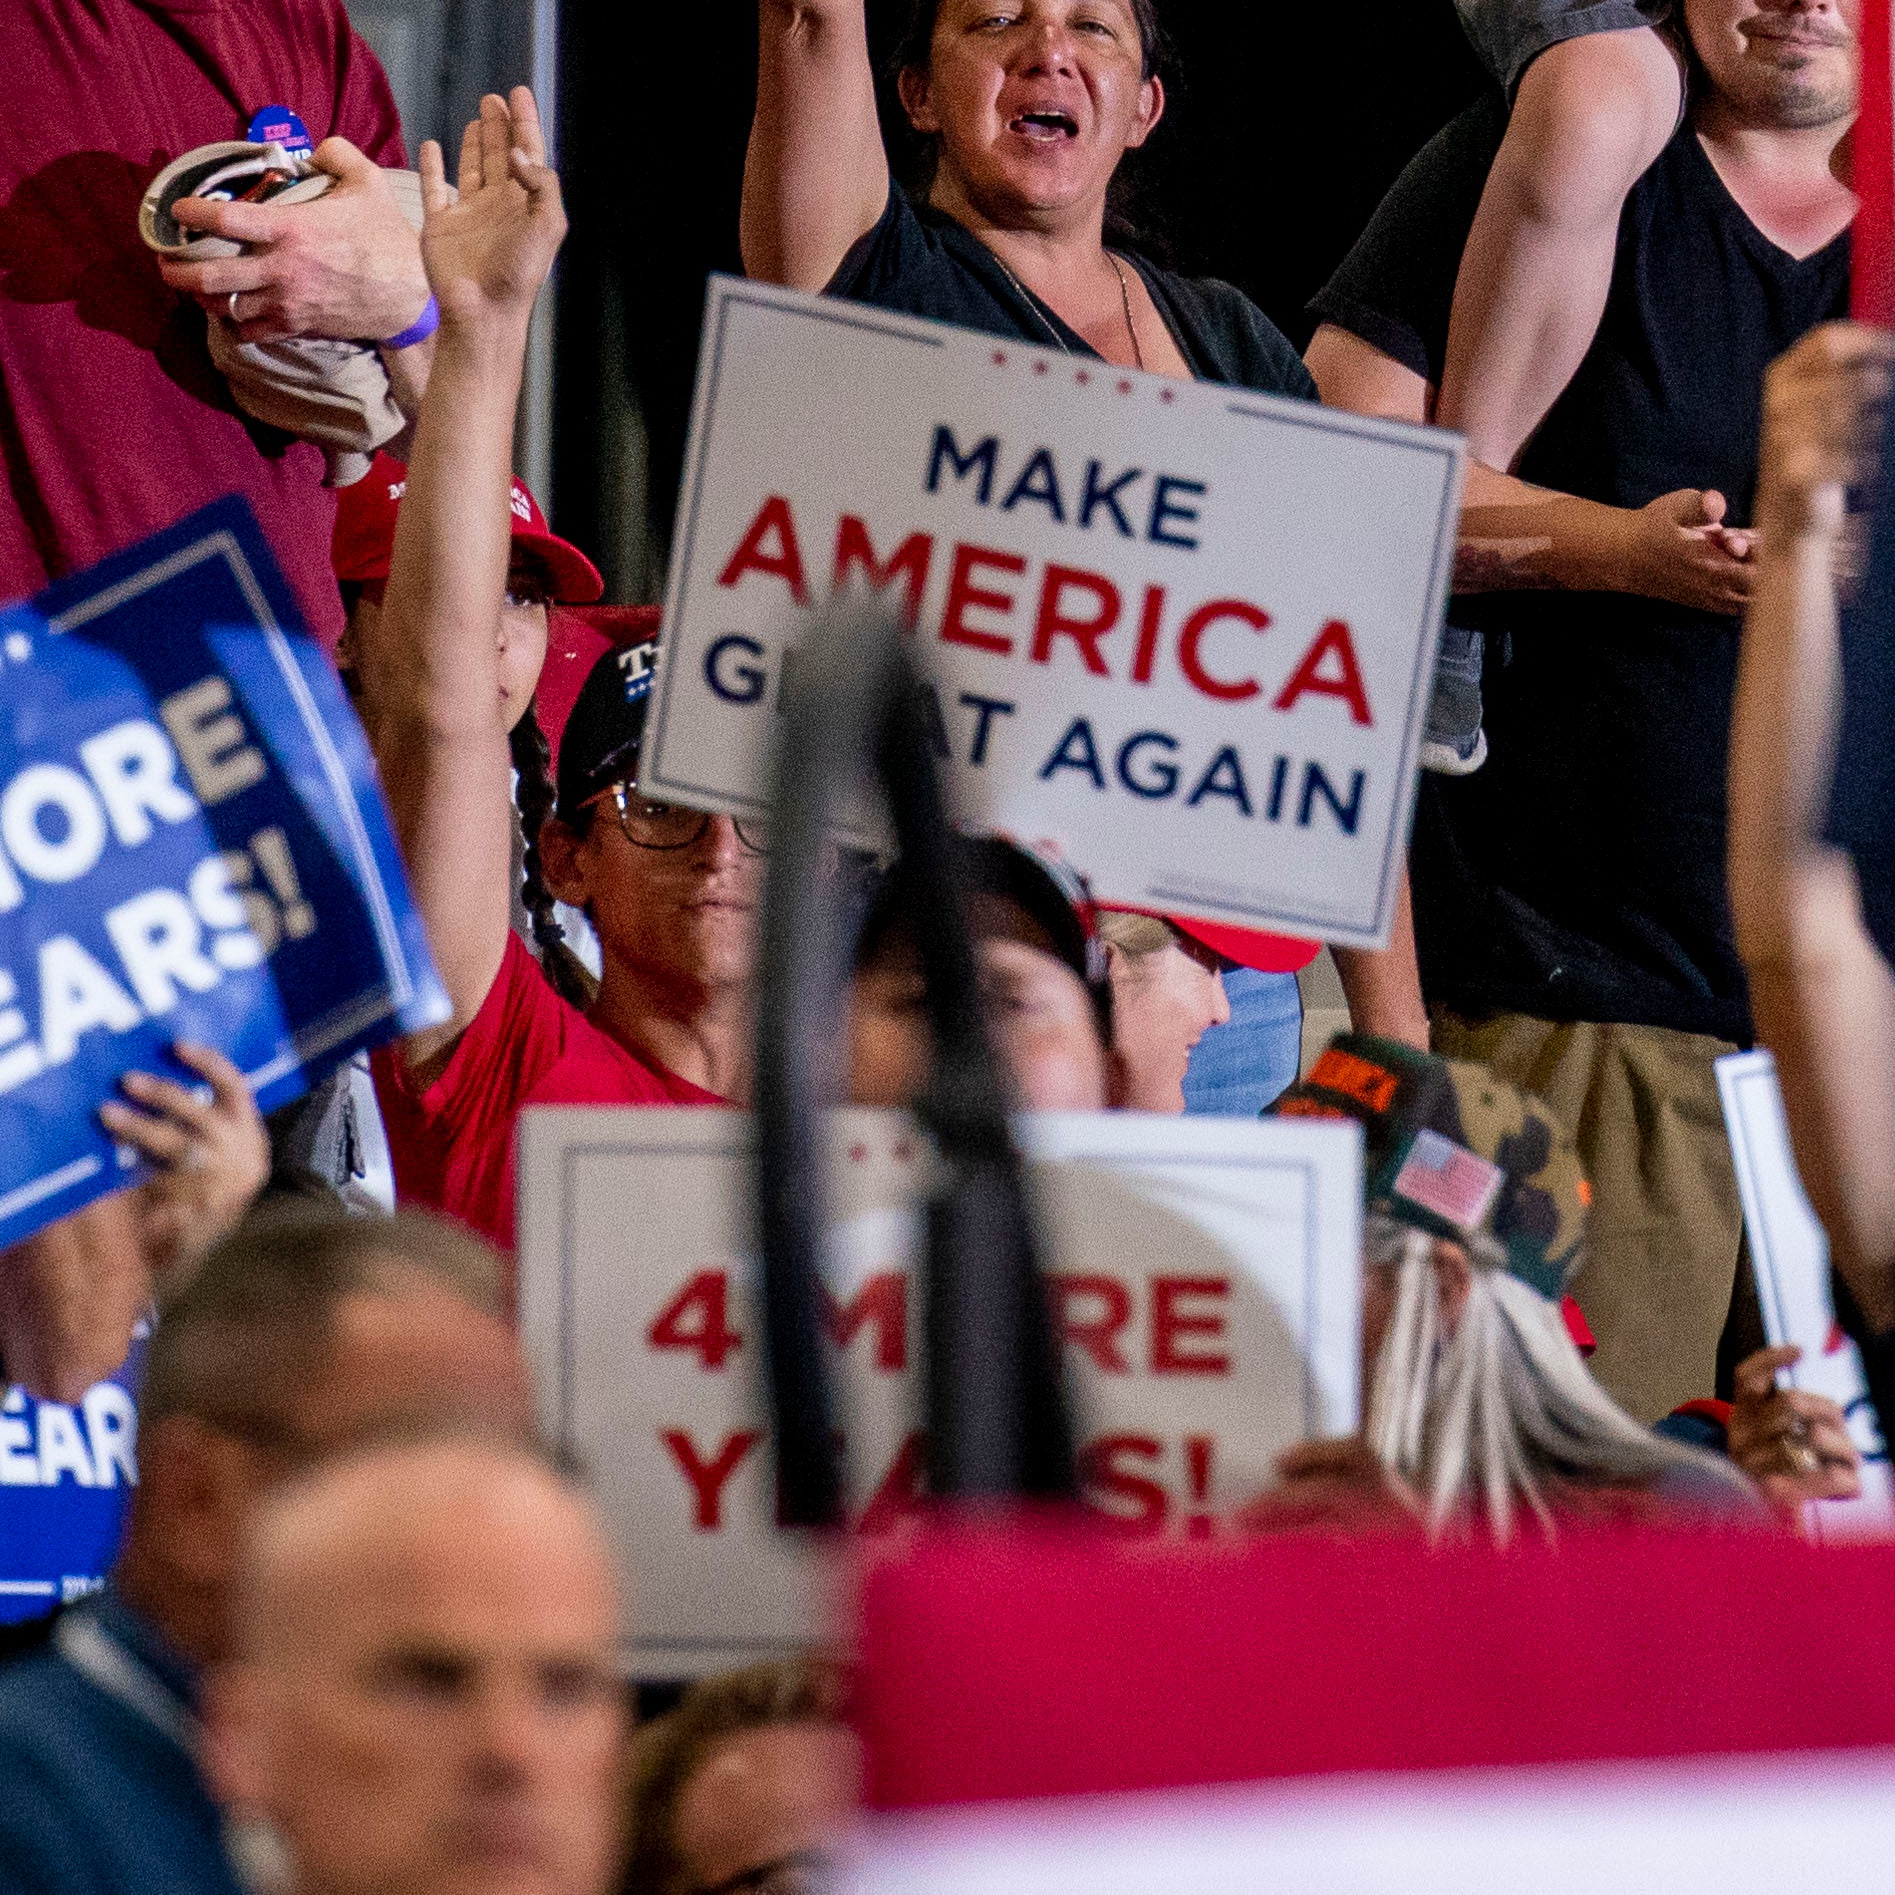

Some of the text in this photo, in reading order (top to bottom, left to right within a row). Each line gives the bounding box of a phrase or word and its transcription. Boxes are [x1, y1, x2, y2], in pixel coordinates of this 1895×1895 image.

[923, 423, 1209, 552] MAKE
[716, 494, 1375, 729] AMERICA
[1039, 716, 1369, 838] AGAIN
[646, 1268, 1234, 1378] 4 MRE
